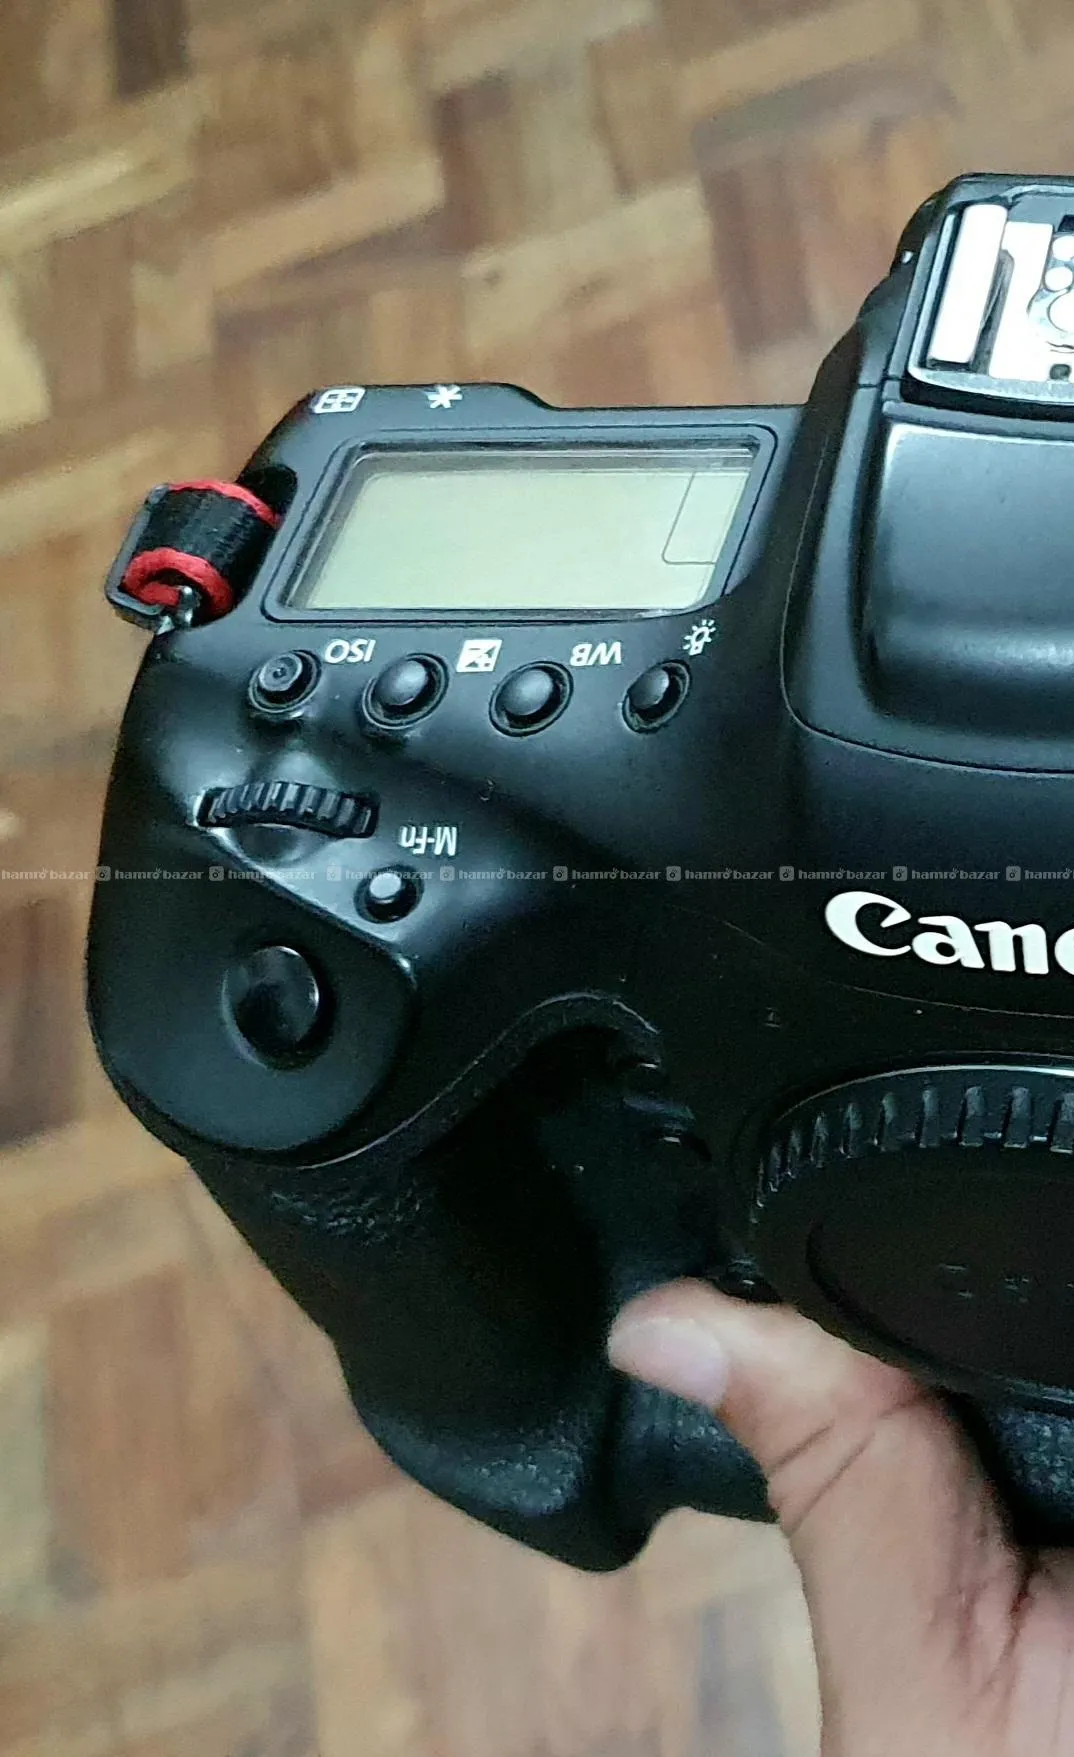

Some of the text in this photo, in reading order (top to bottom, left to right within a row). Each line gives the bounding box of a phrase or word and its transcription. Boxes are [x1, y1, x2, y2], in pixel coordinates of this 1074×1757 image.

[325, 639, 376, 665] ISO
[570, 641, 623, 667] WB
[400, 824, 458, 856] M-Fn
